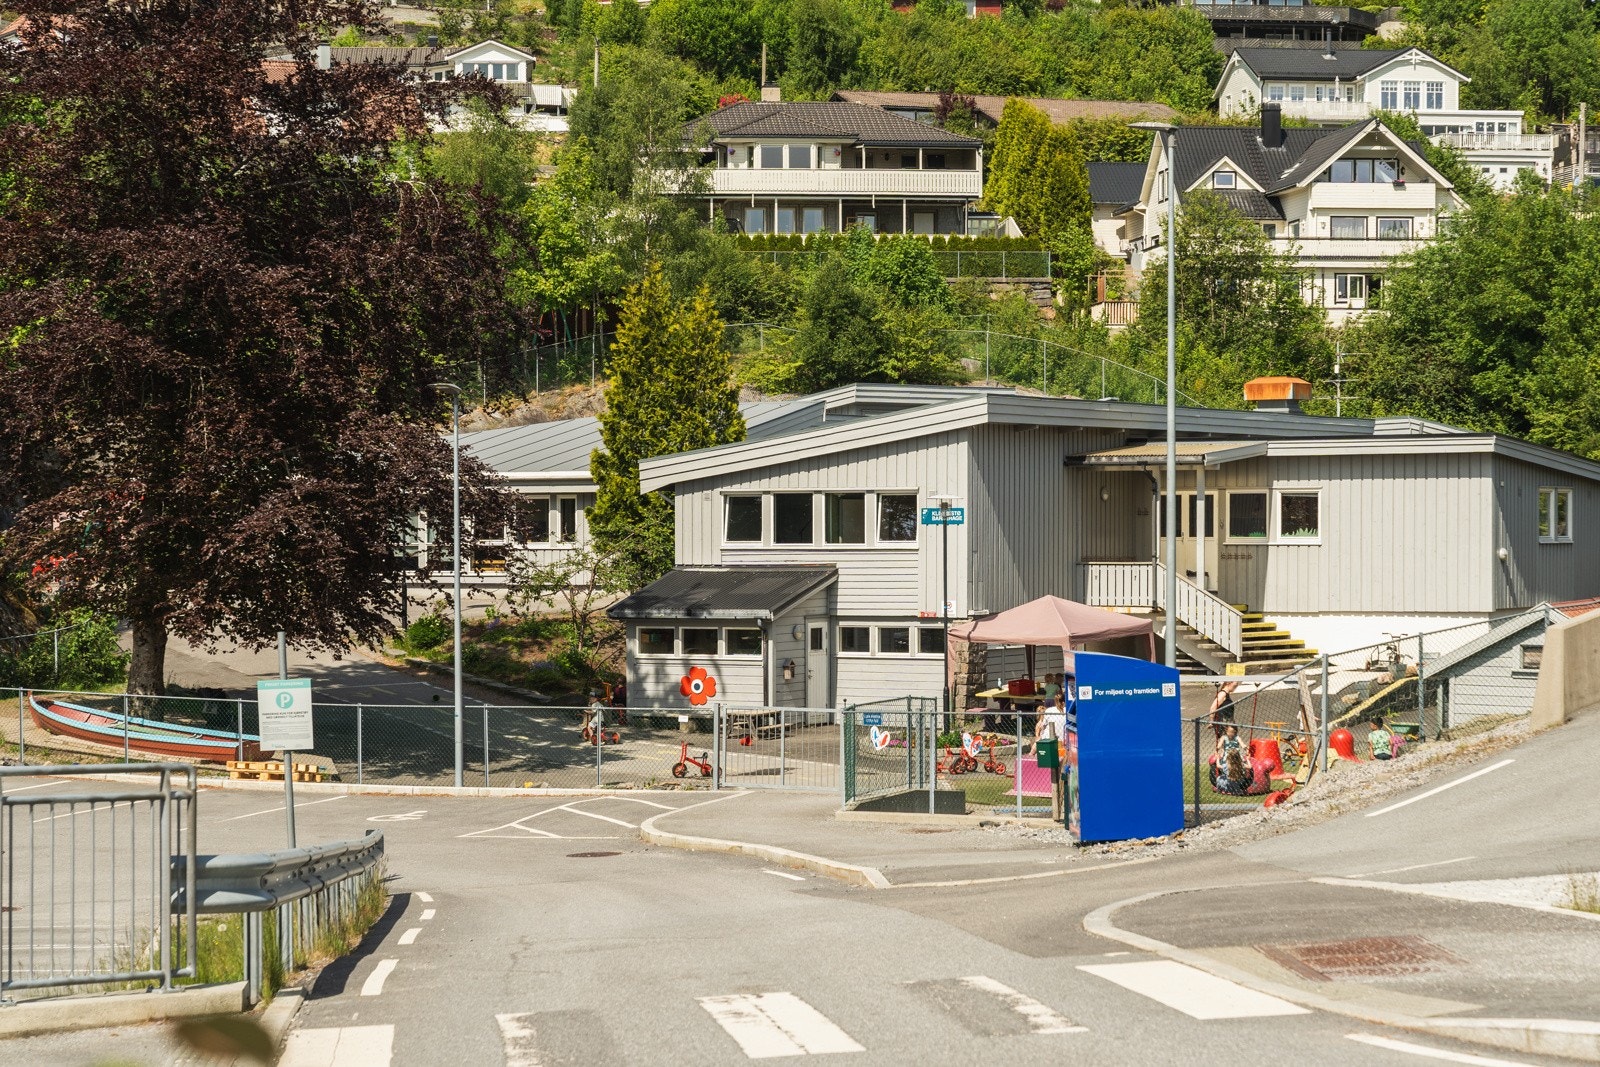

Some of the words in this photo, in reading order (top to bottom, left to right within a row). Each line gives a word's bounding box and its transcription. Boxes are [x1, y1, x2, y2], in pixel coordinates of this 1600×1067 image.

[1105, 688, 1125, 696] miljøet
[1133, 687, 1160, 695] framtiden
[280, 693, 291, 708] P
